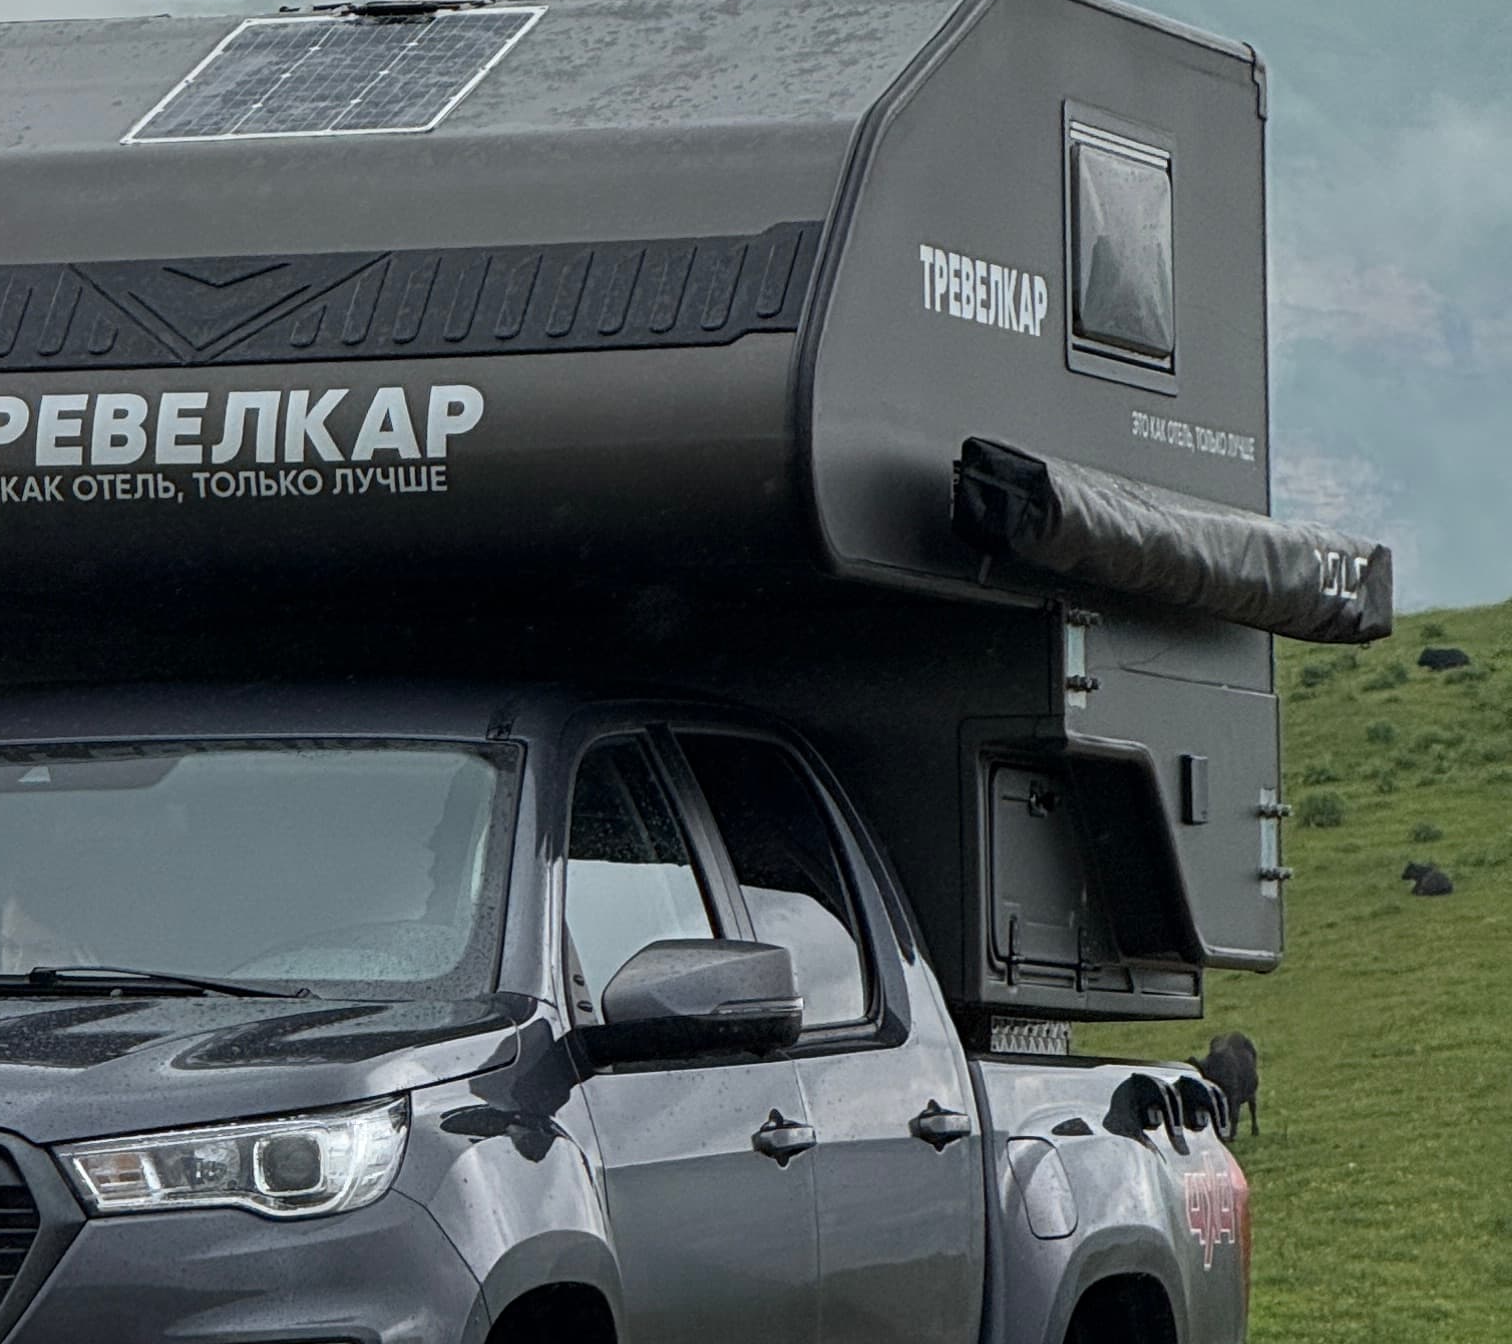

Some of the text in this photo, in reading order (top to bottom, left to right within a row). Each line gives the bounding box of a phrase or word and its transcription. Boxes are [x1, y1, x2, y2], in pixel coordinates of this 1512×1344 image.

[919, 243, 1049, 337] ТРЕВЕЛКАР
[1131, 410, 1148, 437] ЭТО
[1149, 416, 1167, 442] КАК
[0, 475, 64, 503] КАК
[72, 472, 184, 504] ОТЕЛЬ,
[193, 468, 326, 499] ТОЛЬКО
[332, 464, 448, 496] ЛУЧШЕ
